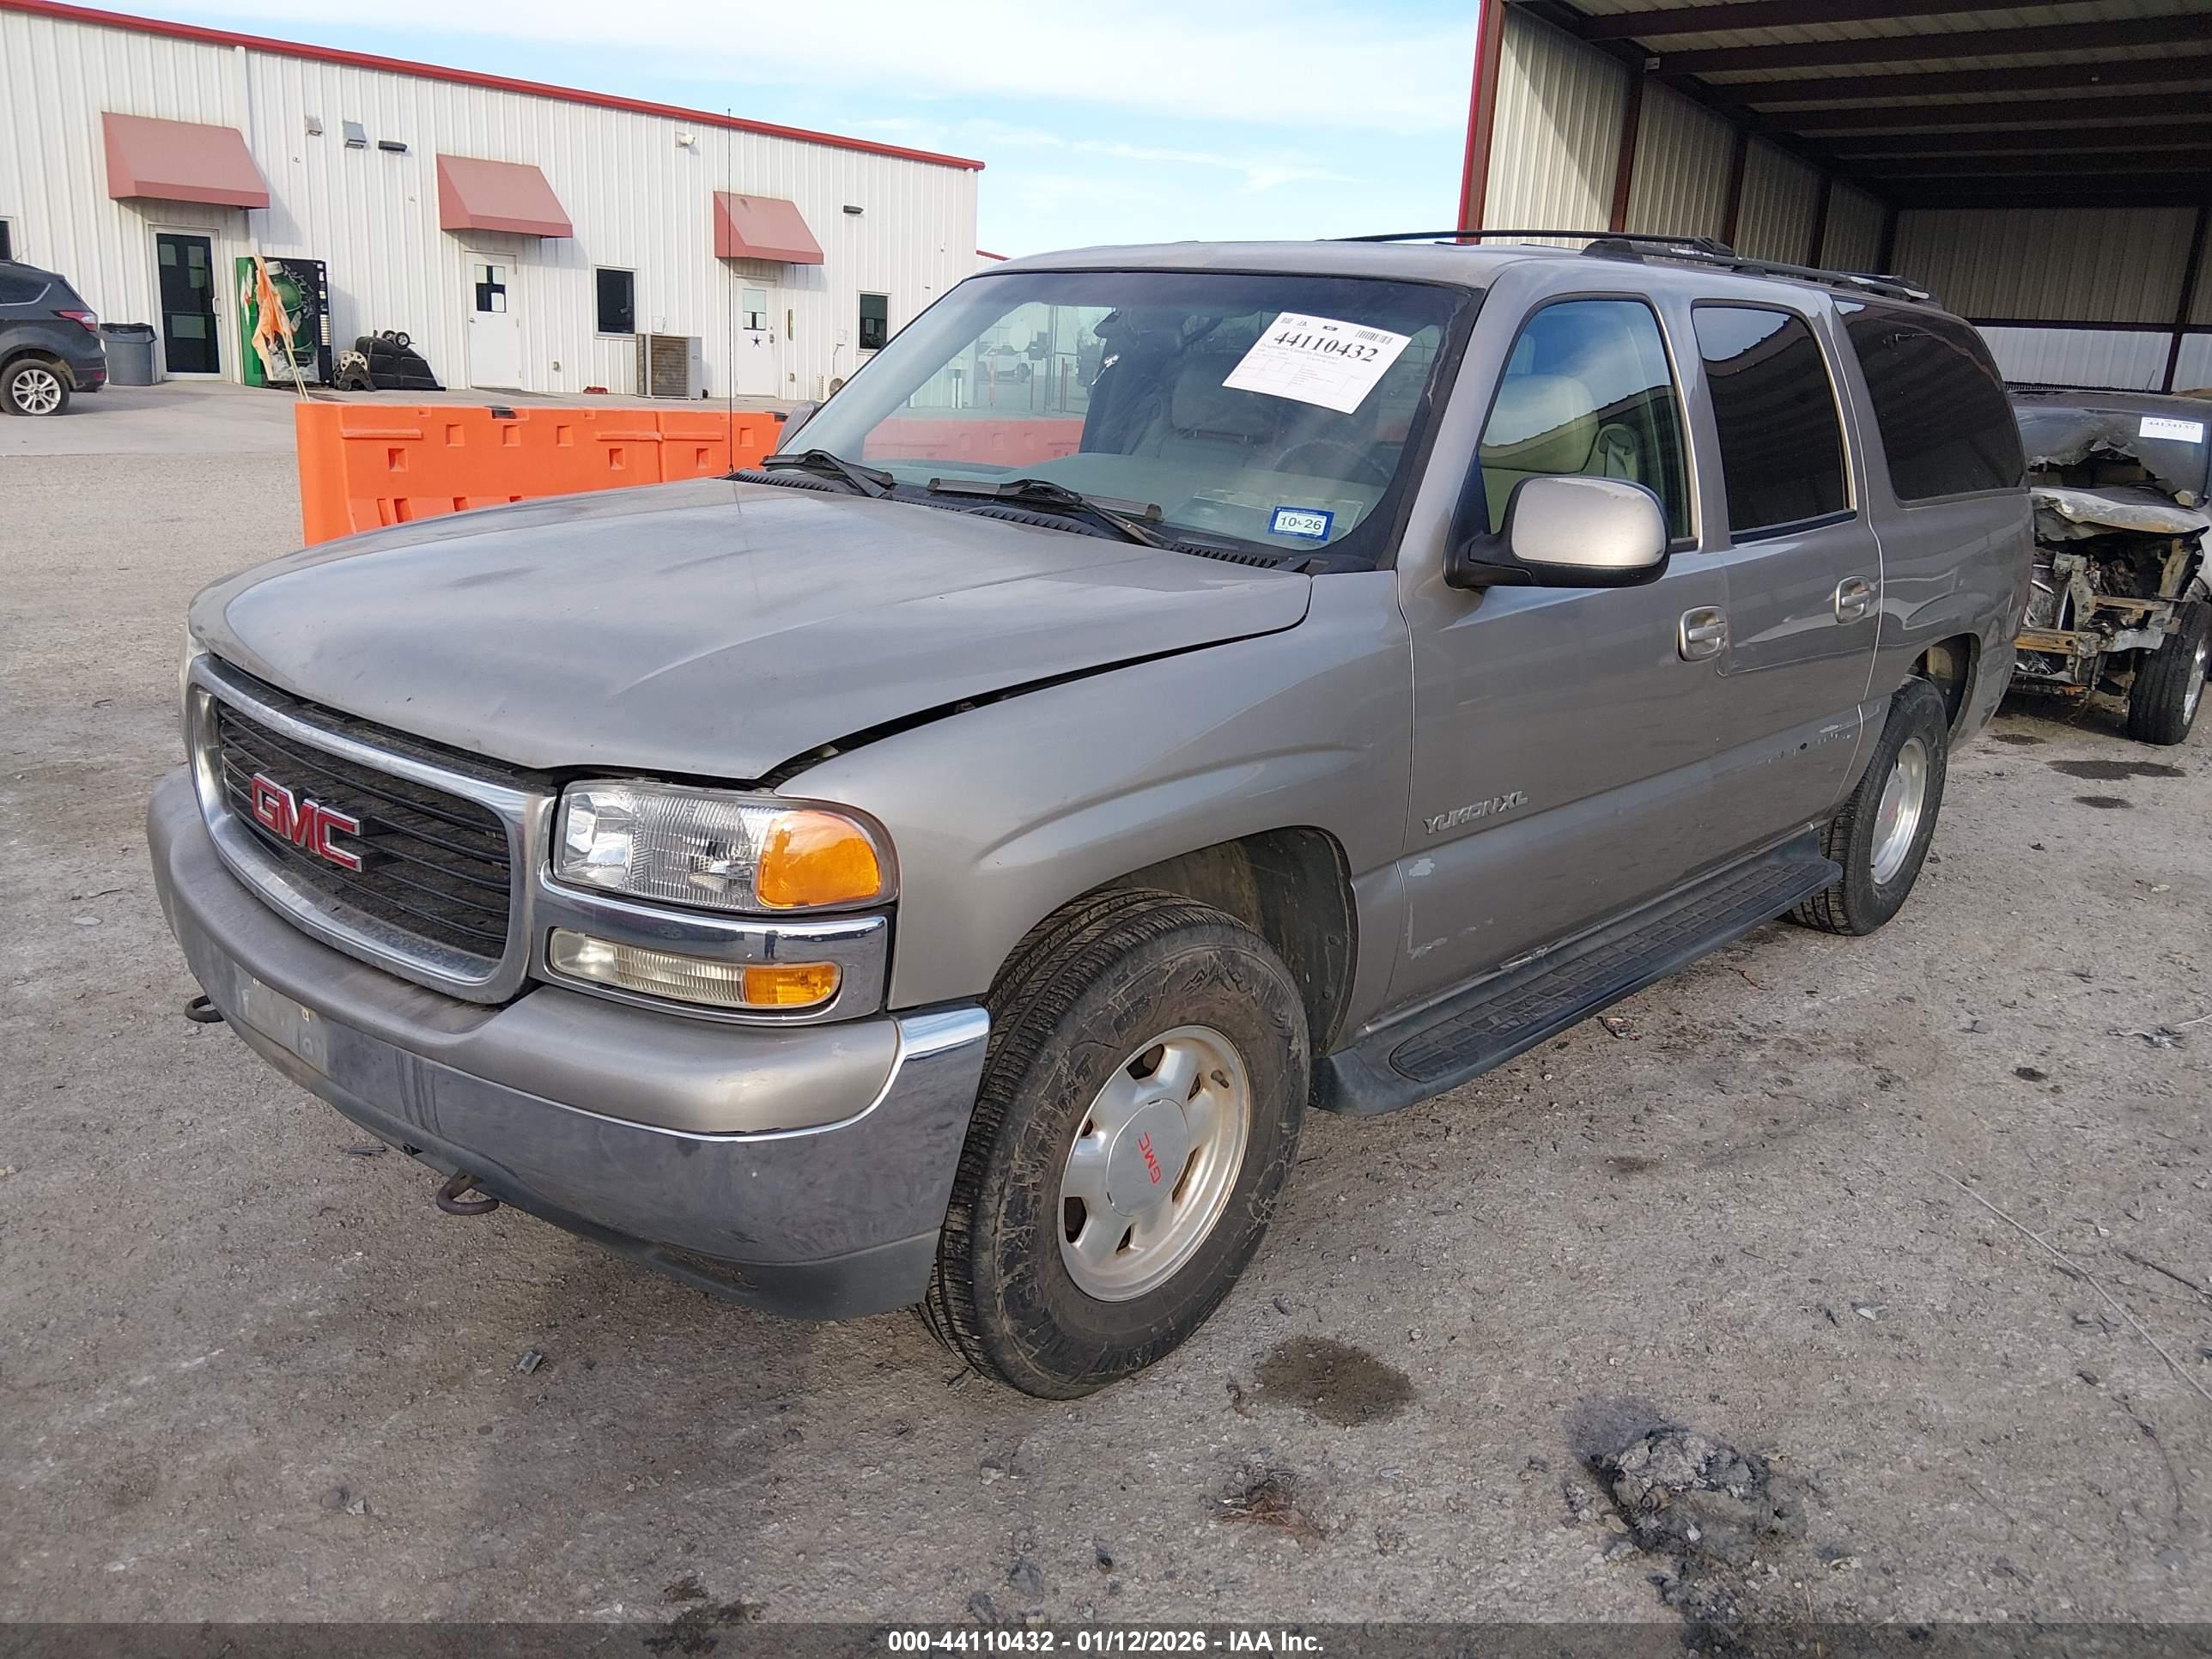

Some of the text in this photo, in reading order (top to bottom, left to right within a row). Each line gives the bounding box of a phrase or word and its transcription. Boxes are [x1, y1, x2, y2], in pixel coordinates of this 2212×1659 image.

[1274, 331, 1379, 362] 44110432
[252, 772, 362, 873] GMC
[1137, 1131, 1161, 1184] GMC
